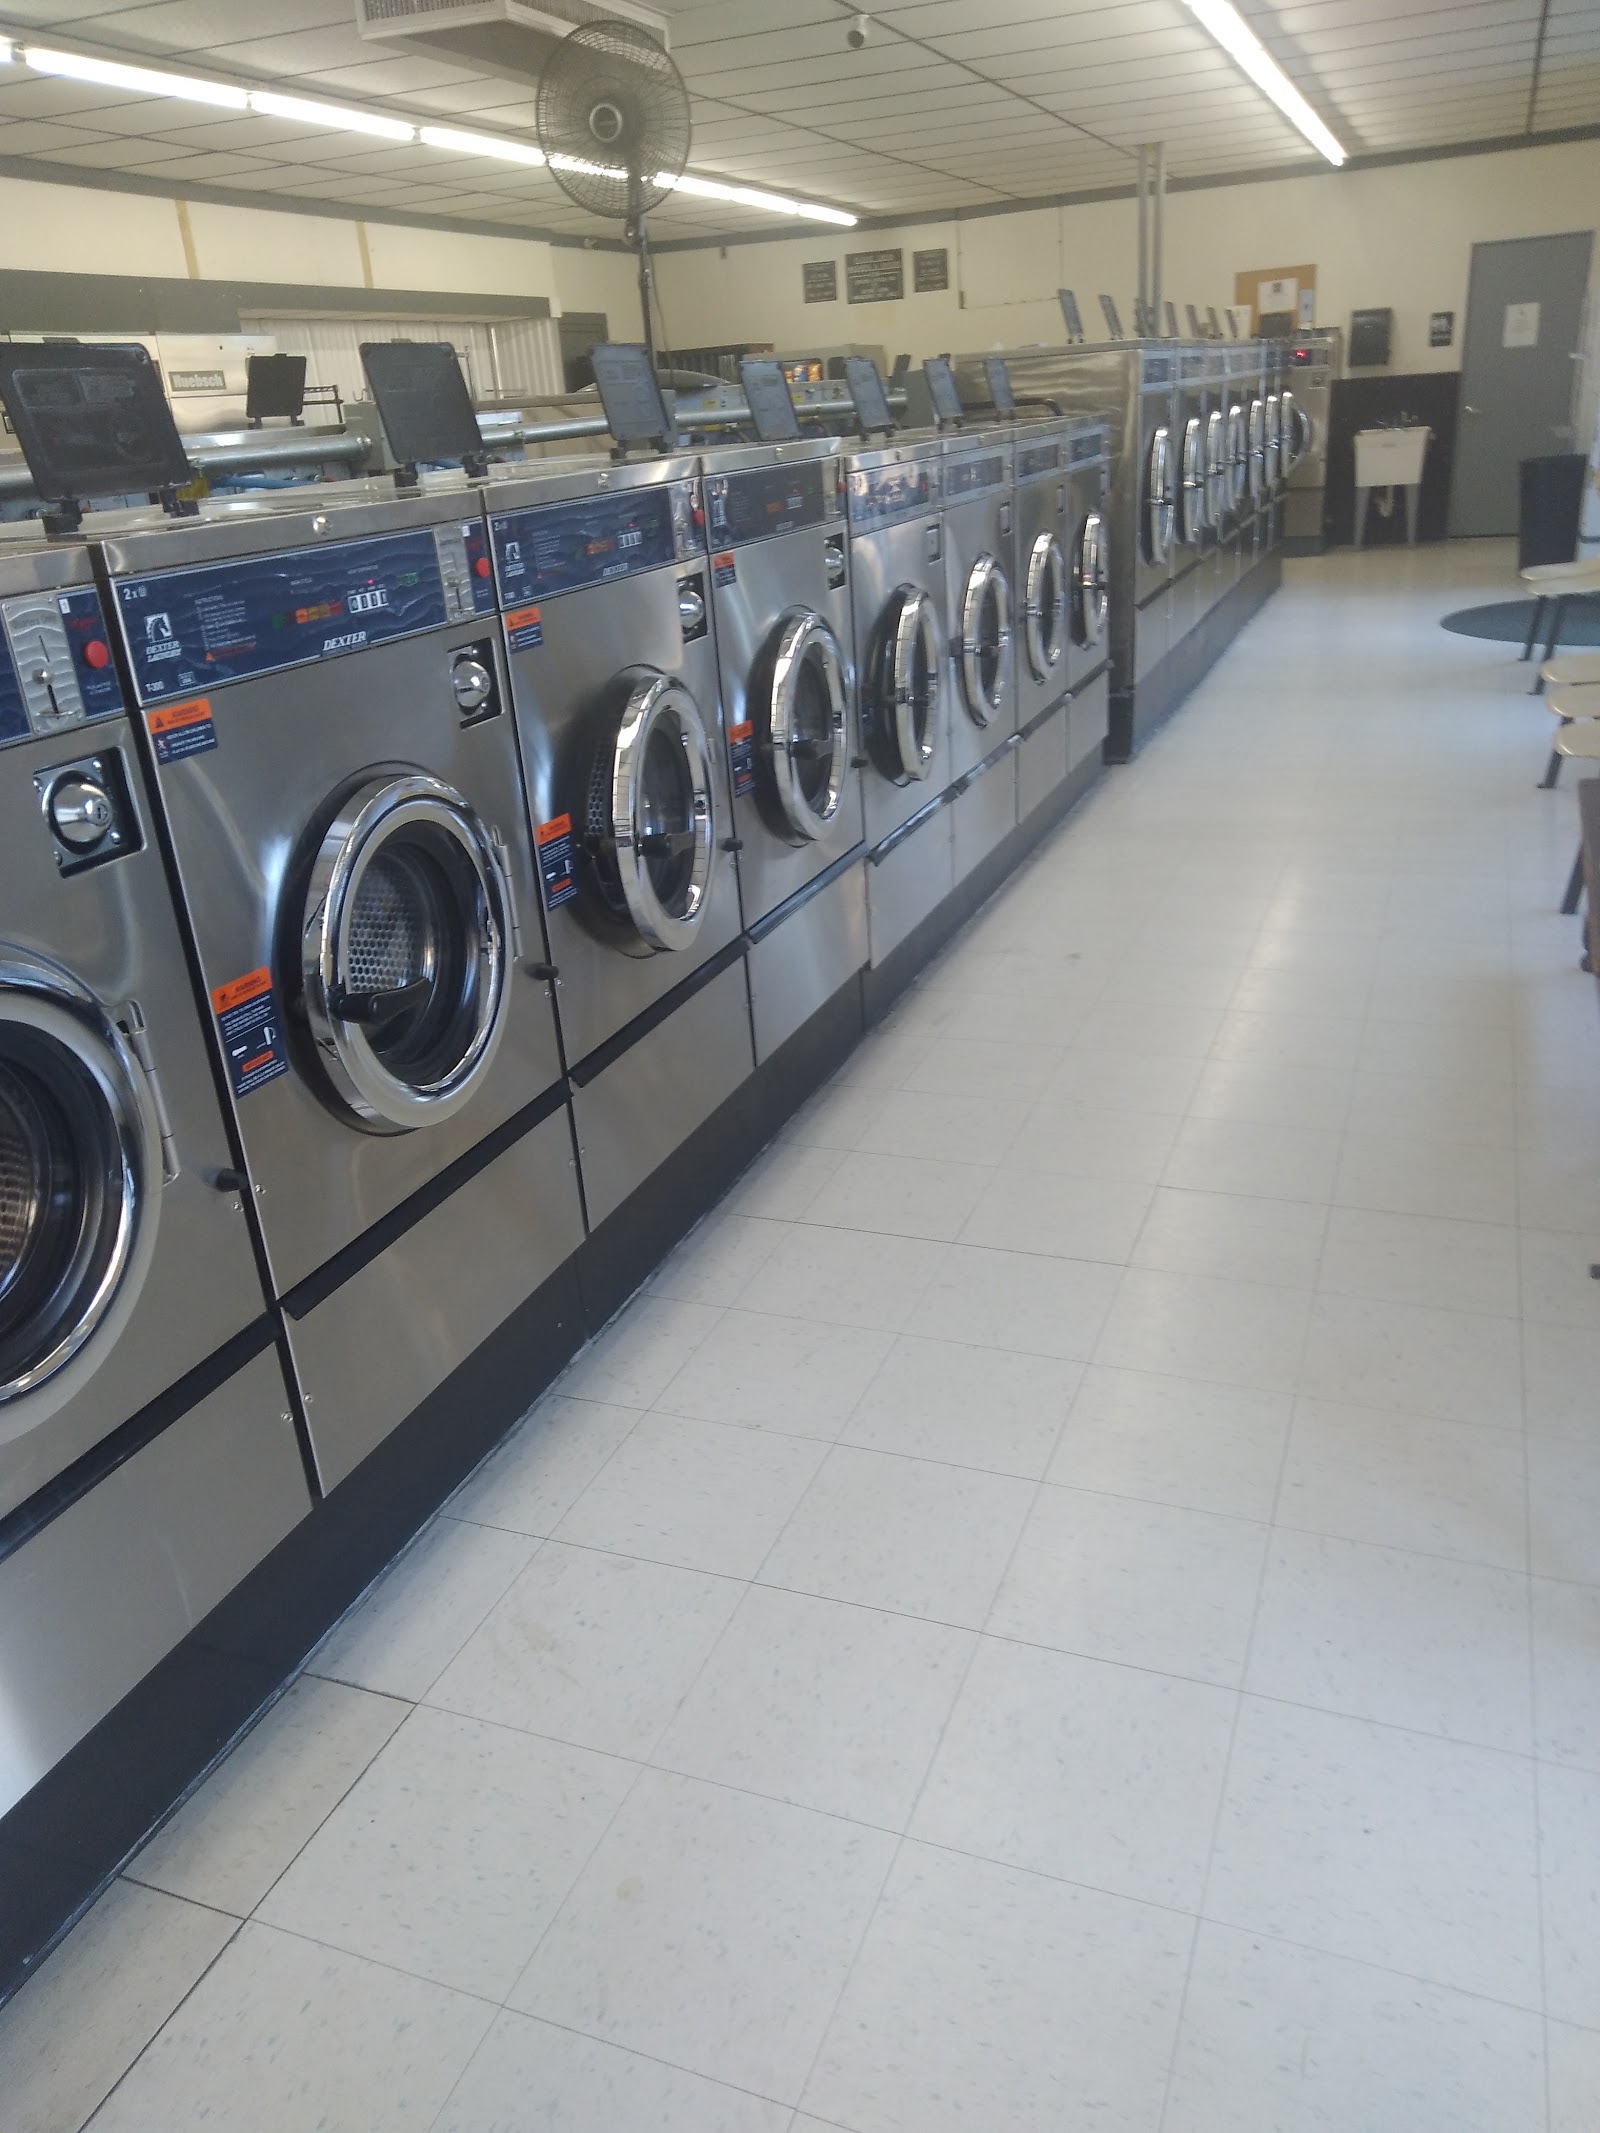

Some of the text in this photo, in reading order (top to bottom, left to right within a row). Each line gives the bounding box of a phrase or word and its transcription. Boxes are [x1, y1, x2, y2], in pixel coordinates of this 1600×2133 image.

[172, 373, 223, 388] Huebsch
[146, 640, 180, 655] DEXTER
[323, 630, 367, 651] DEXTER
